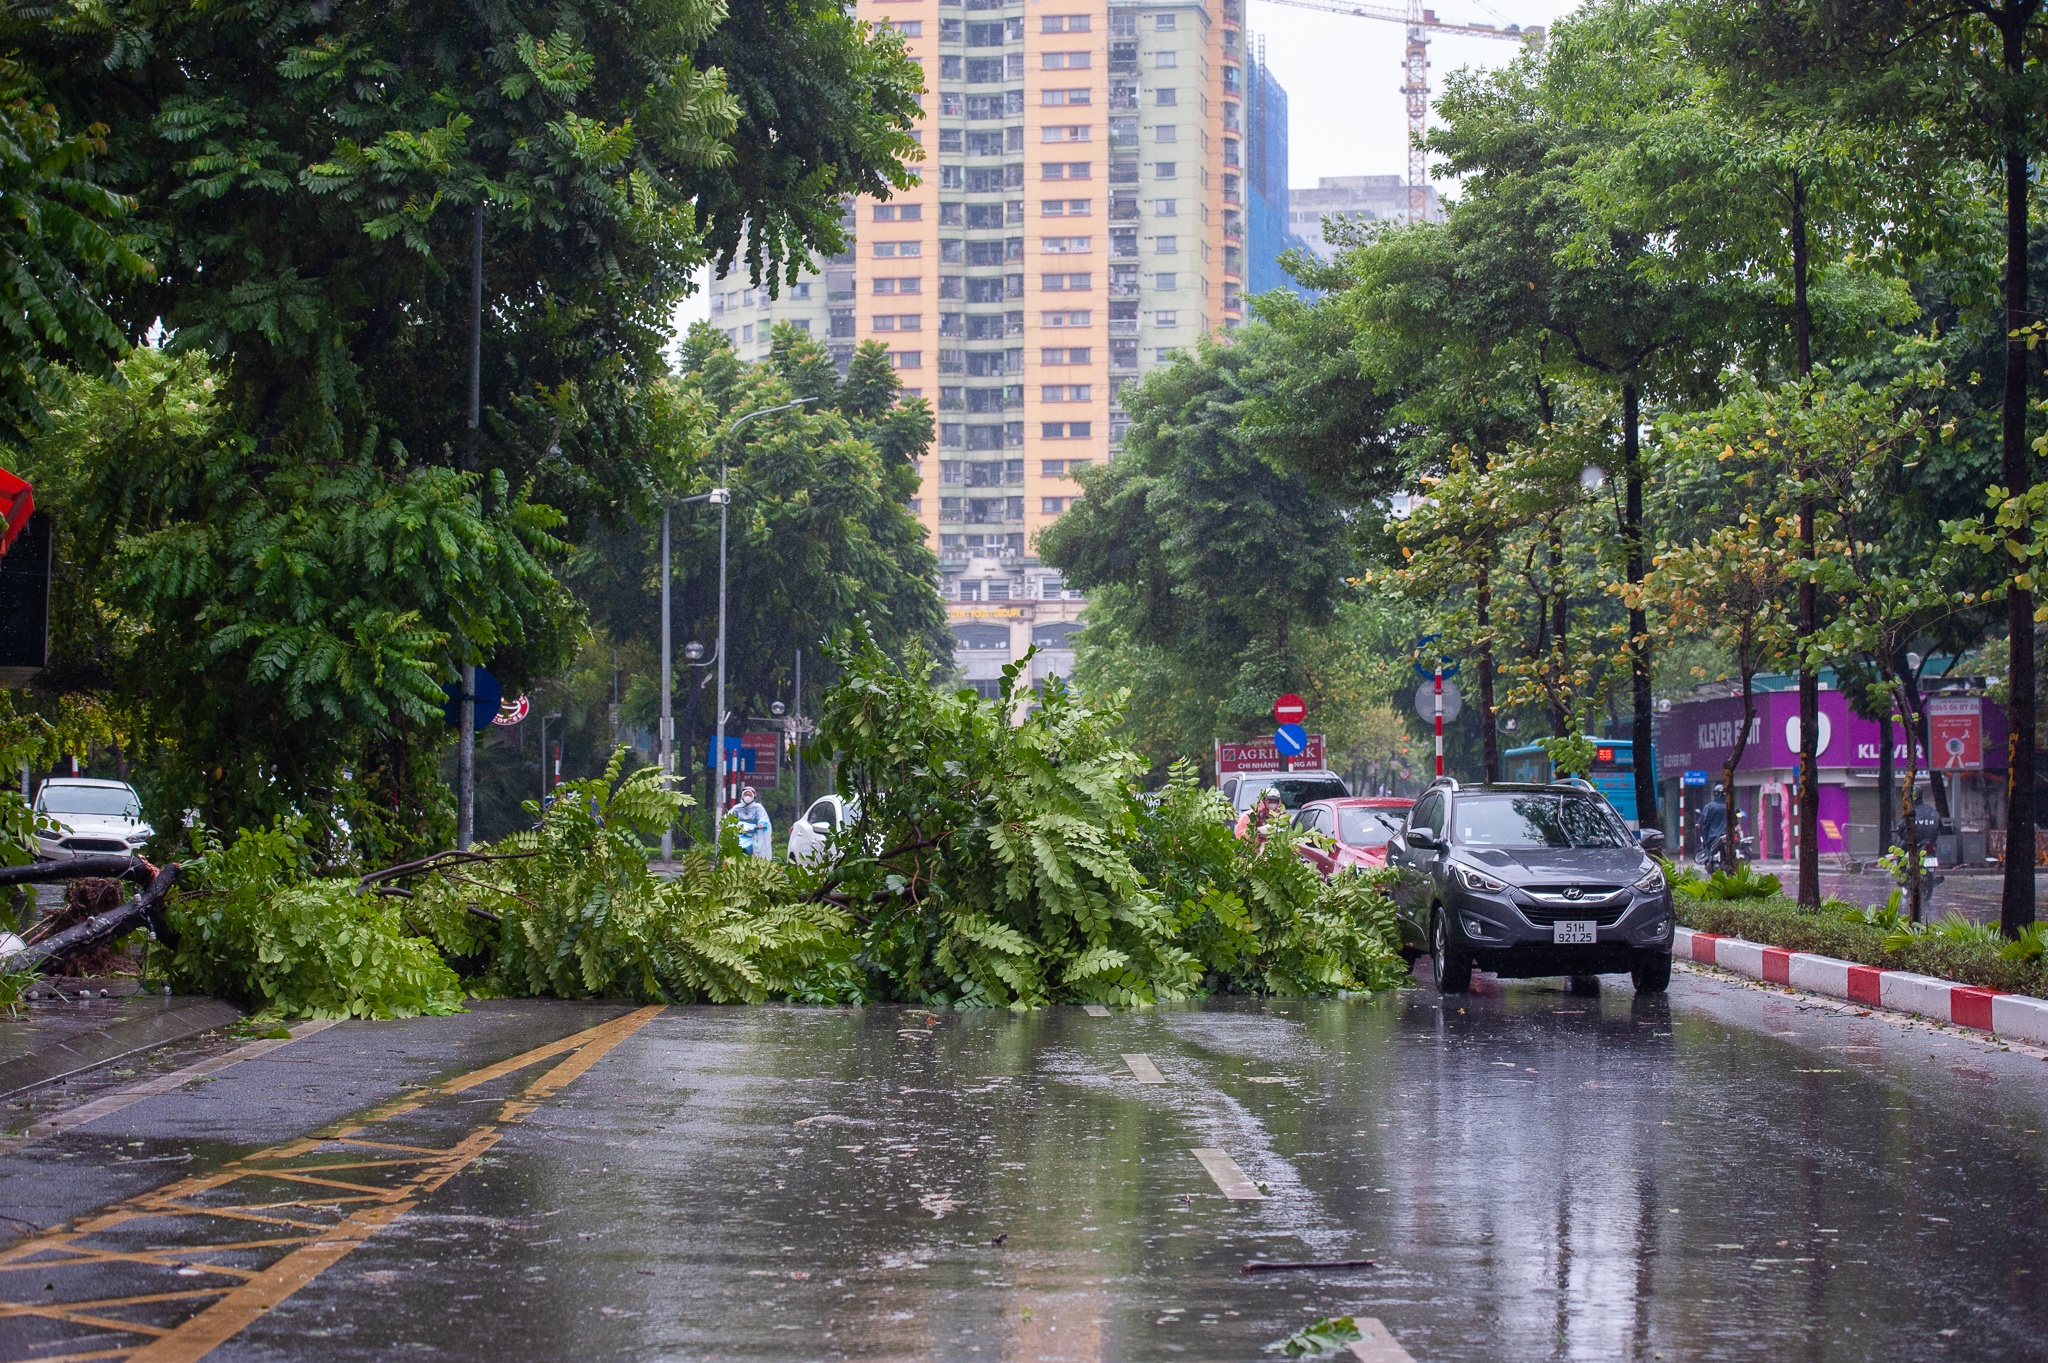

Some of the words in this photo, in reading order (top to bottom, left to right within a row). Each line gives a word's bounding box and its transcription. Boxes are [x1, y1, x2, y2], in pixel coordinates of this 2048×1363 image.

[1699, 722, 1733, 750] KLEVER
[1734, 717, 1761, 746] FUIT
[1858, 743, 1924, 759] KLVER
[1252, 760, 1279, 769] NHÁNH
[1566, 923, 1585, 932] 51H
[1558, 933, 1592, 942] 921.25
